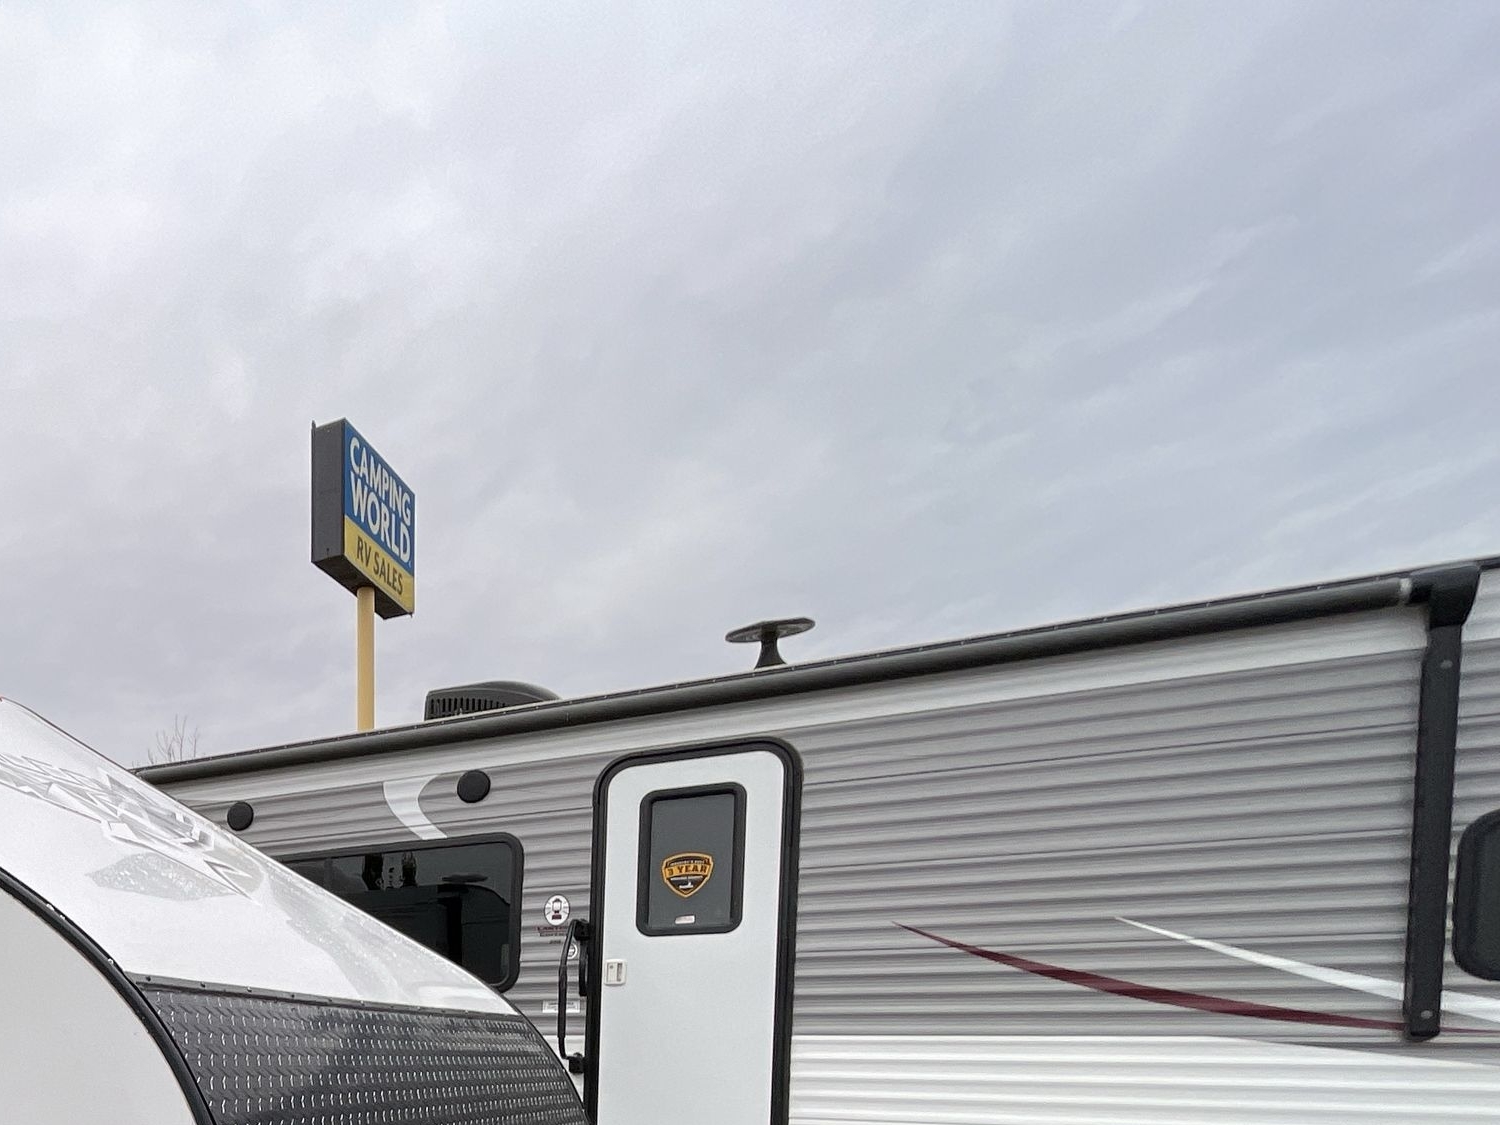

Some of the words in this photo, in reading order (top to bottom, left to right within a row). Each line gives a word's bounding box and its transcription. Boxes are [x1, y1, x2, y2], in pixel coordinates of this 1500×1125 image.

[350, 436, 411, 527] CAMPING
[350, 471, 411, 564] WORLD
[357, 536, 372, 564] RV
[373, 550, 404, 596] SALES
[677, 865, 708, 874] YEAR
